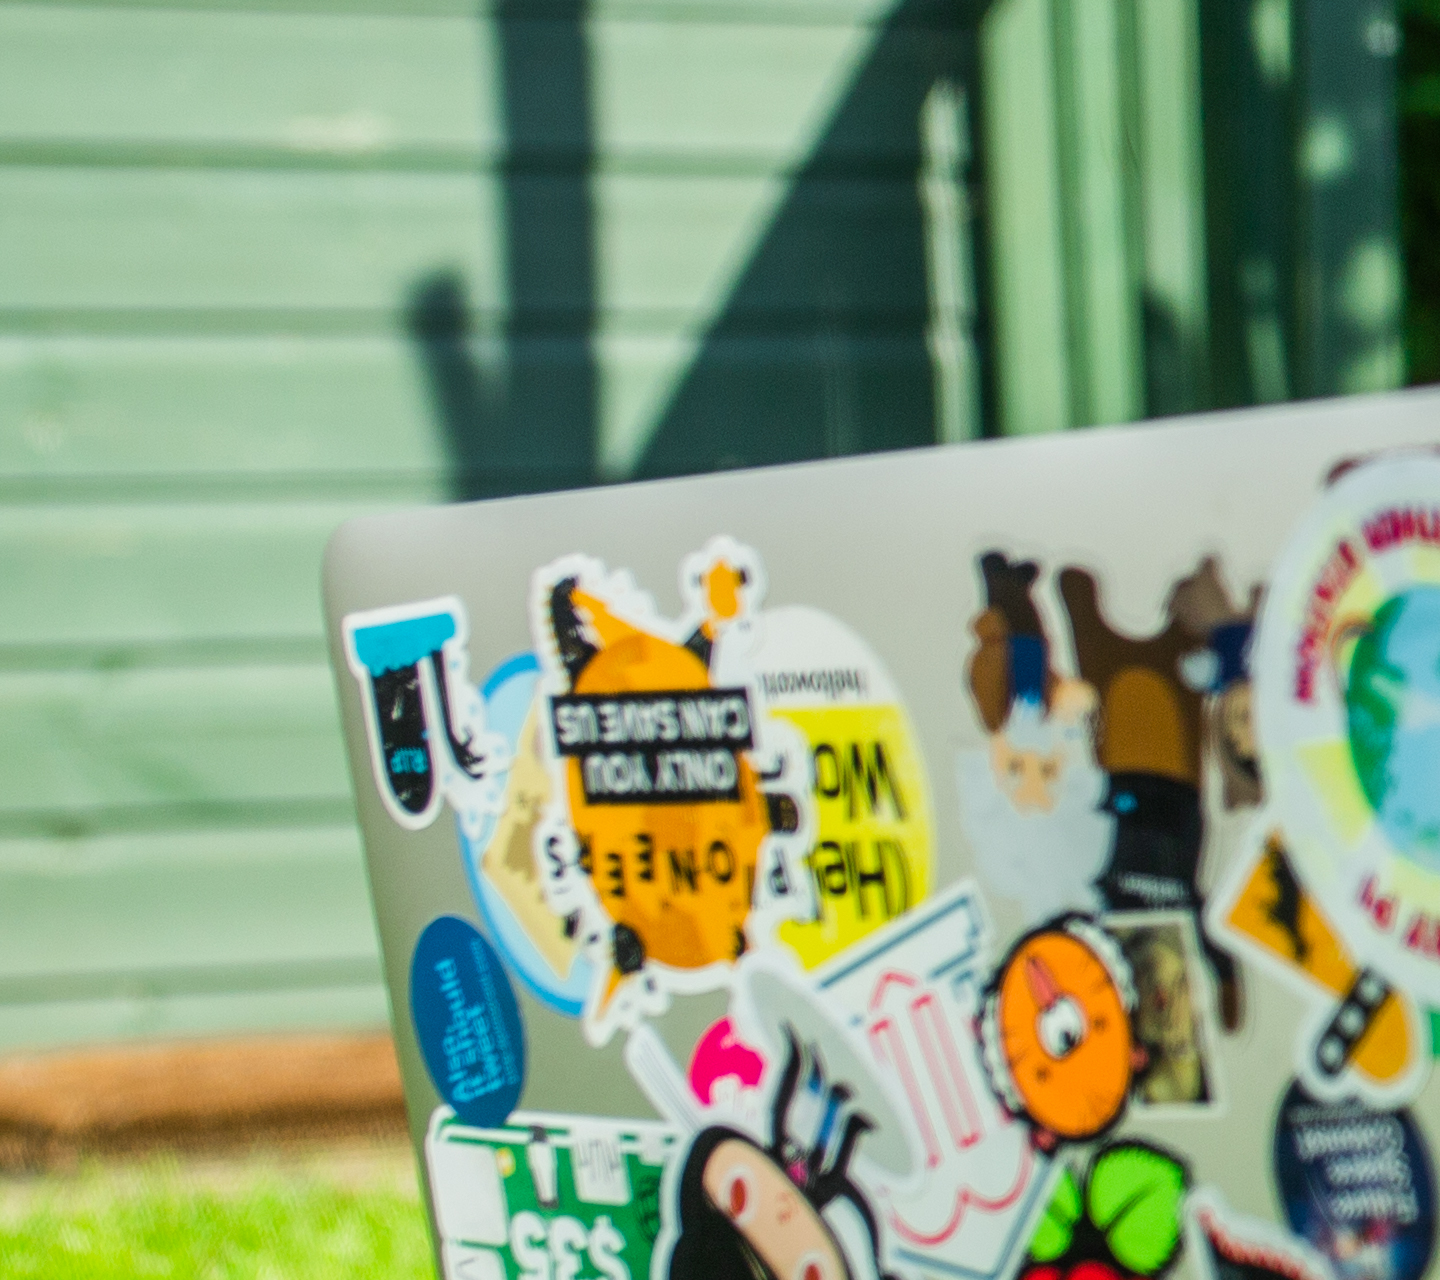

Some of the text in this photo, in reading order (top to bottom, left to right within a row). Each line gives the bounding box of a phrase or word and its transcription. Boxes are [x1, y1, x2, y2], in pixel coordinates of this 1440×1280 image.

[555, 698, 748, 746] CAN SAVE US
[586, 748, 736, 795] ONLY YOU
